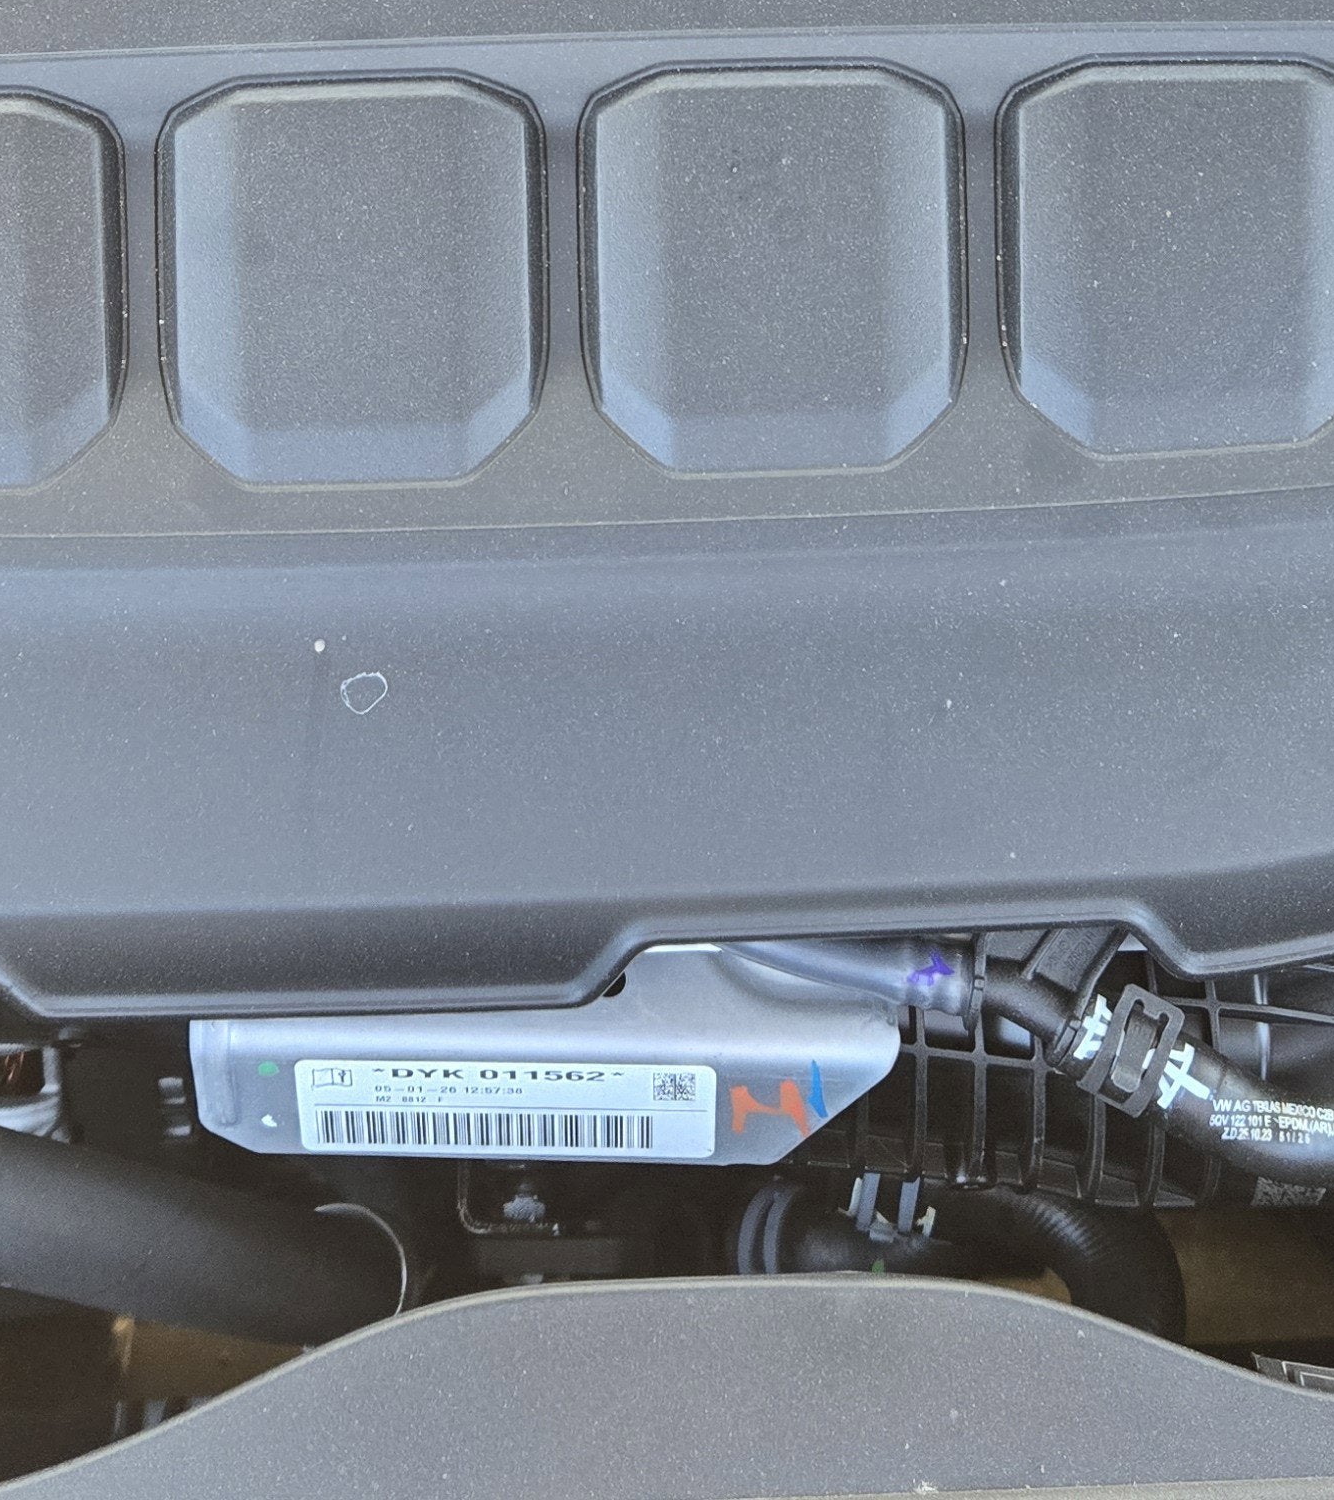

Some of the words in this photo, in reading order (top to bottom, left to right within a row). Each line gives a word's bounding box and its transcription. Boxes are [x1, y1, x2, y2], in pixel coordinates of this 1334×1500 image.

[1212, 1099, 1232, 1112] VW
[1233, 1099, 1252, 1112] AG
[1230, 1114, 1246, 1127] 122
[1247, 1114, 1263, 1127] 101
